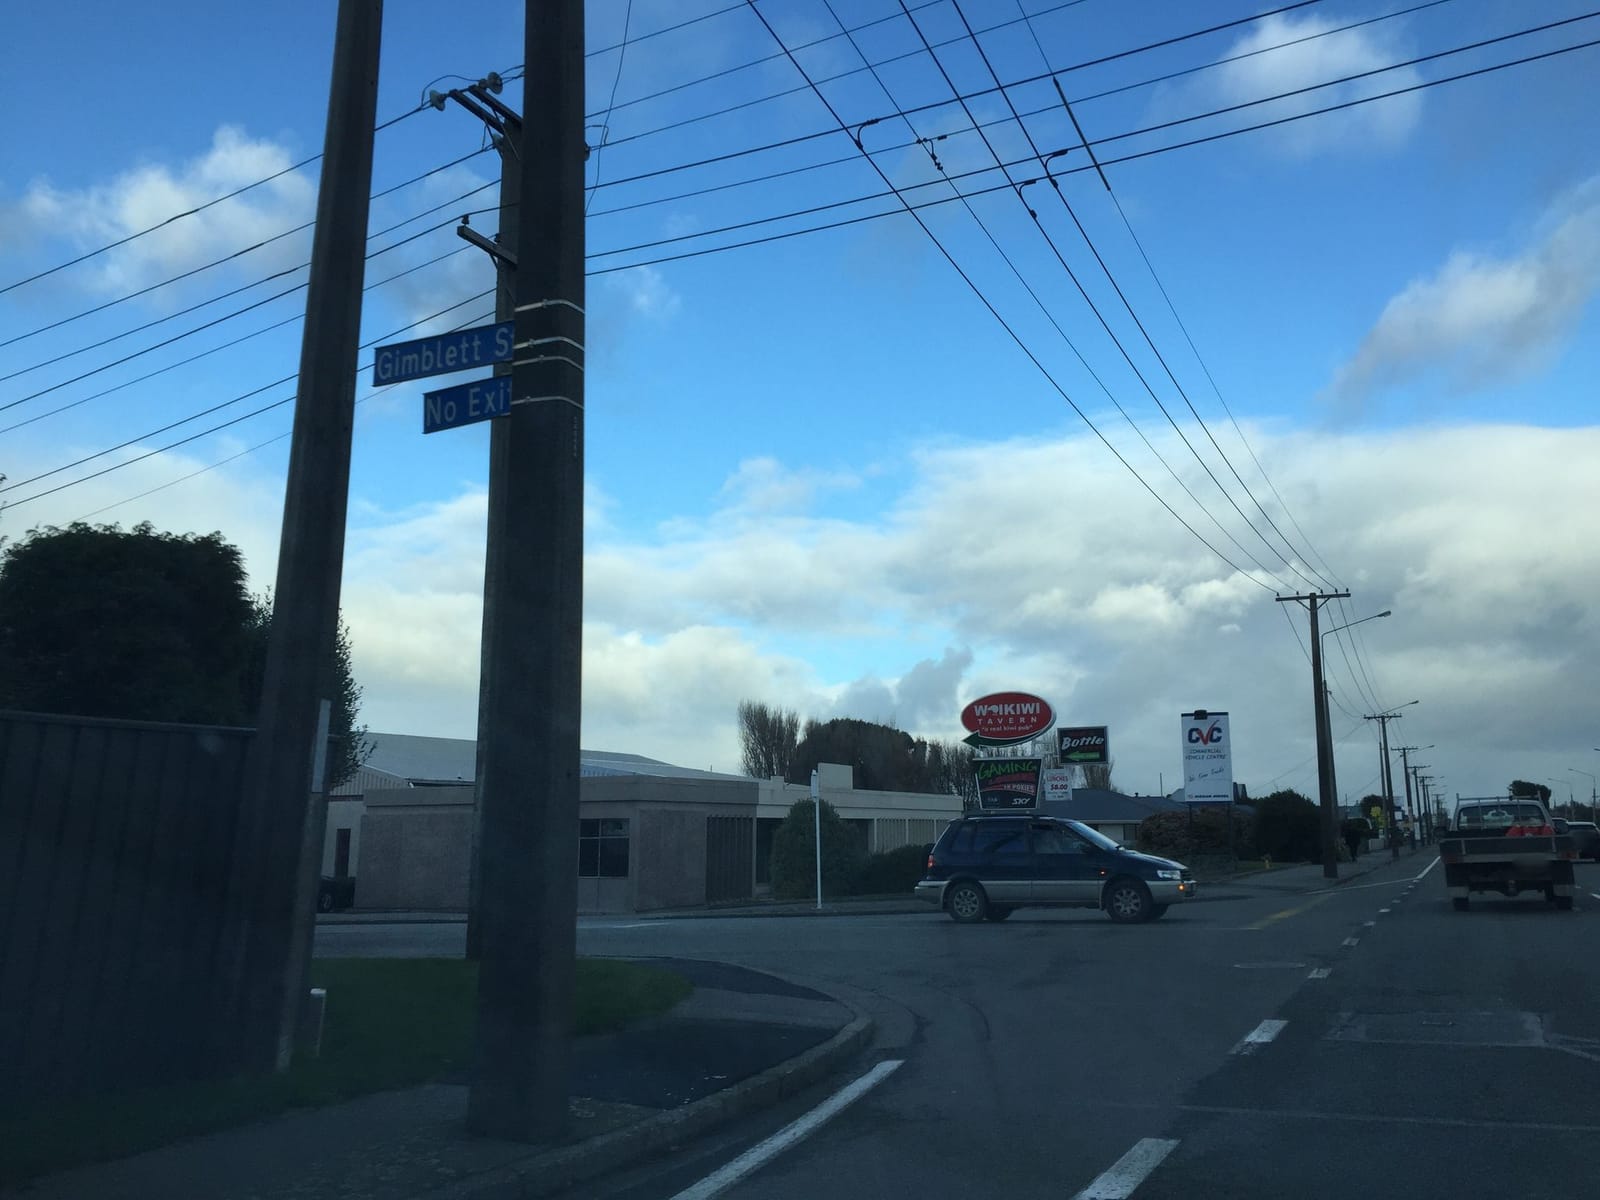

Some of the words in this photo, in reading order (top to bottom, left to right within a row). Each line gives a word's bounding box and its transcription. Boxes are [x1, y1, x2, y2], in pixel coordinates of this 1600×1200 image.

[377, 335, 481, 379] Gimblett
[494, 326, 515, 358] S
[426, 397, 457, 428] No
[978, 717, 1037, 725] TAVERN
[1188, 719, 1222, 746] CVC
[1061, 735, 1105, 751] Bottle
[978, 761, 1037, 780] GAMING
[1011, 797, 1031, 805] SKY
